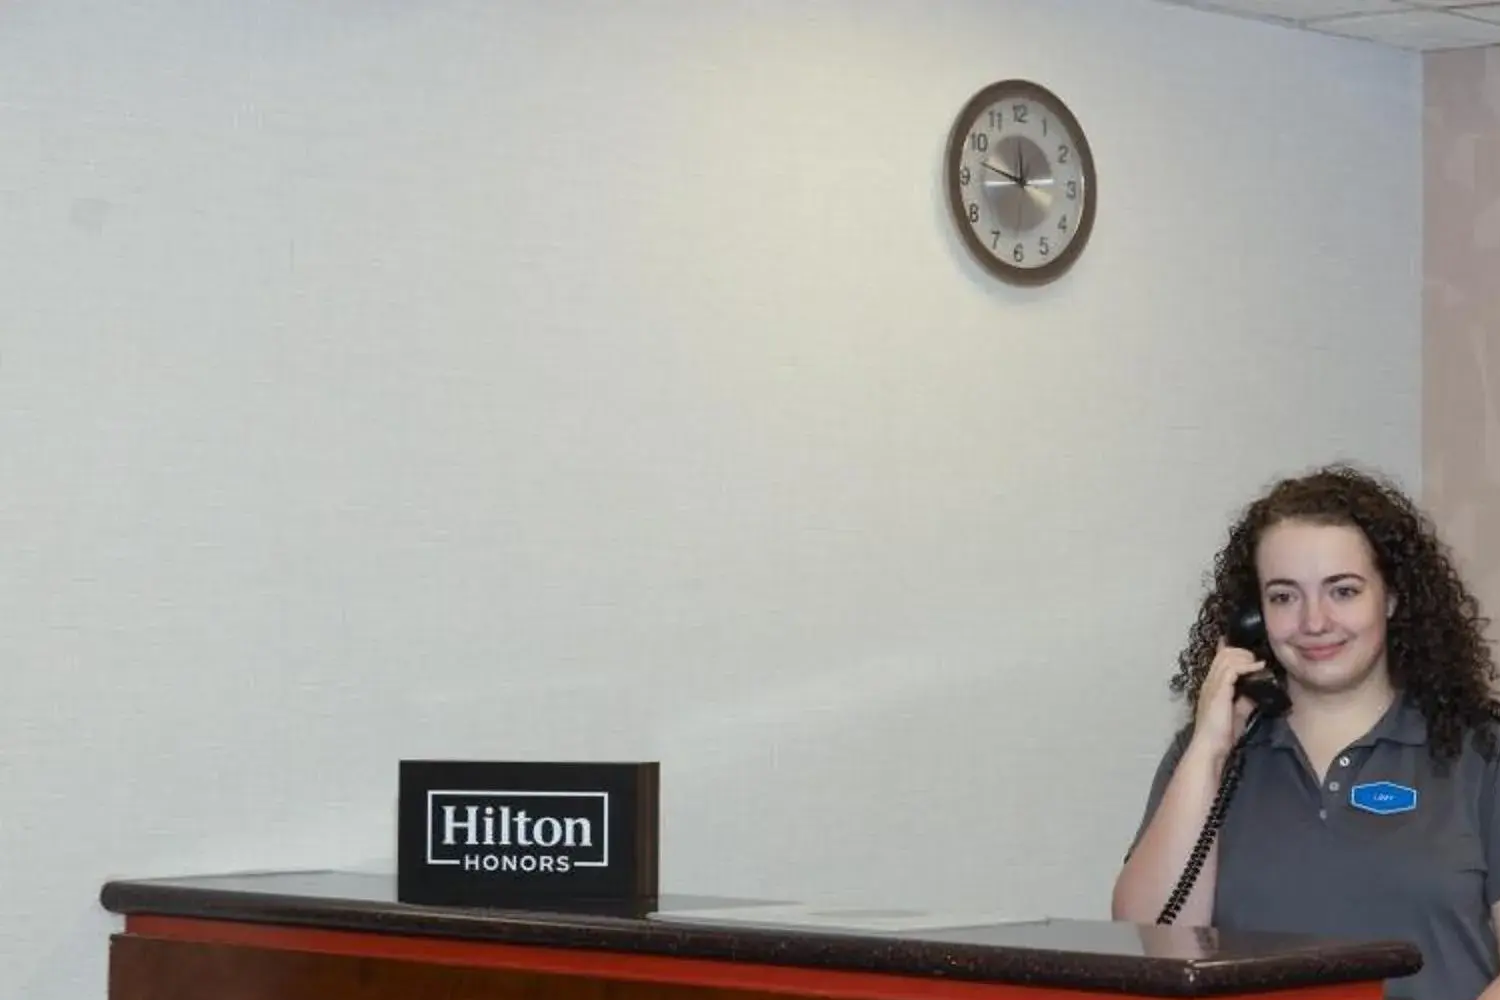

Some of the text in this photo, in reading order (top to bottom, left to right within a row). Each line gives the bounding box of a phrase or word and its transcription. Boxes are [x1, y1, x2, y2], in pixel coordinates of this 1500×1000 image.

[988, 111, 1003, 130] 11
[1012, 104, 1028, 123] 12
[1041, 119, 1048, 136] 1
[971, 133, 989, 153] 10
[1057, 145, 1069, 164] 2
[960, 168, 971, 186] 9
[1065, 180, 1076, 199] 3
[969, 203, 980, 223] 8
[1057, 215, 1067, 233] 4
[991, 230, 1001, 250] 7
[1039, 236, 1050, 256] 5
[1013, 243, 1024, 263] 6
[441, 805, 593, 847] Hilton
[464, 854, 571, 873] HONORS
